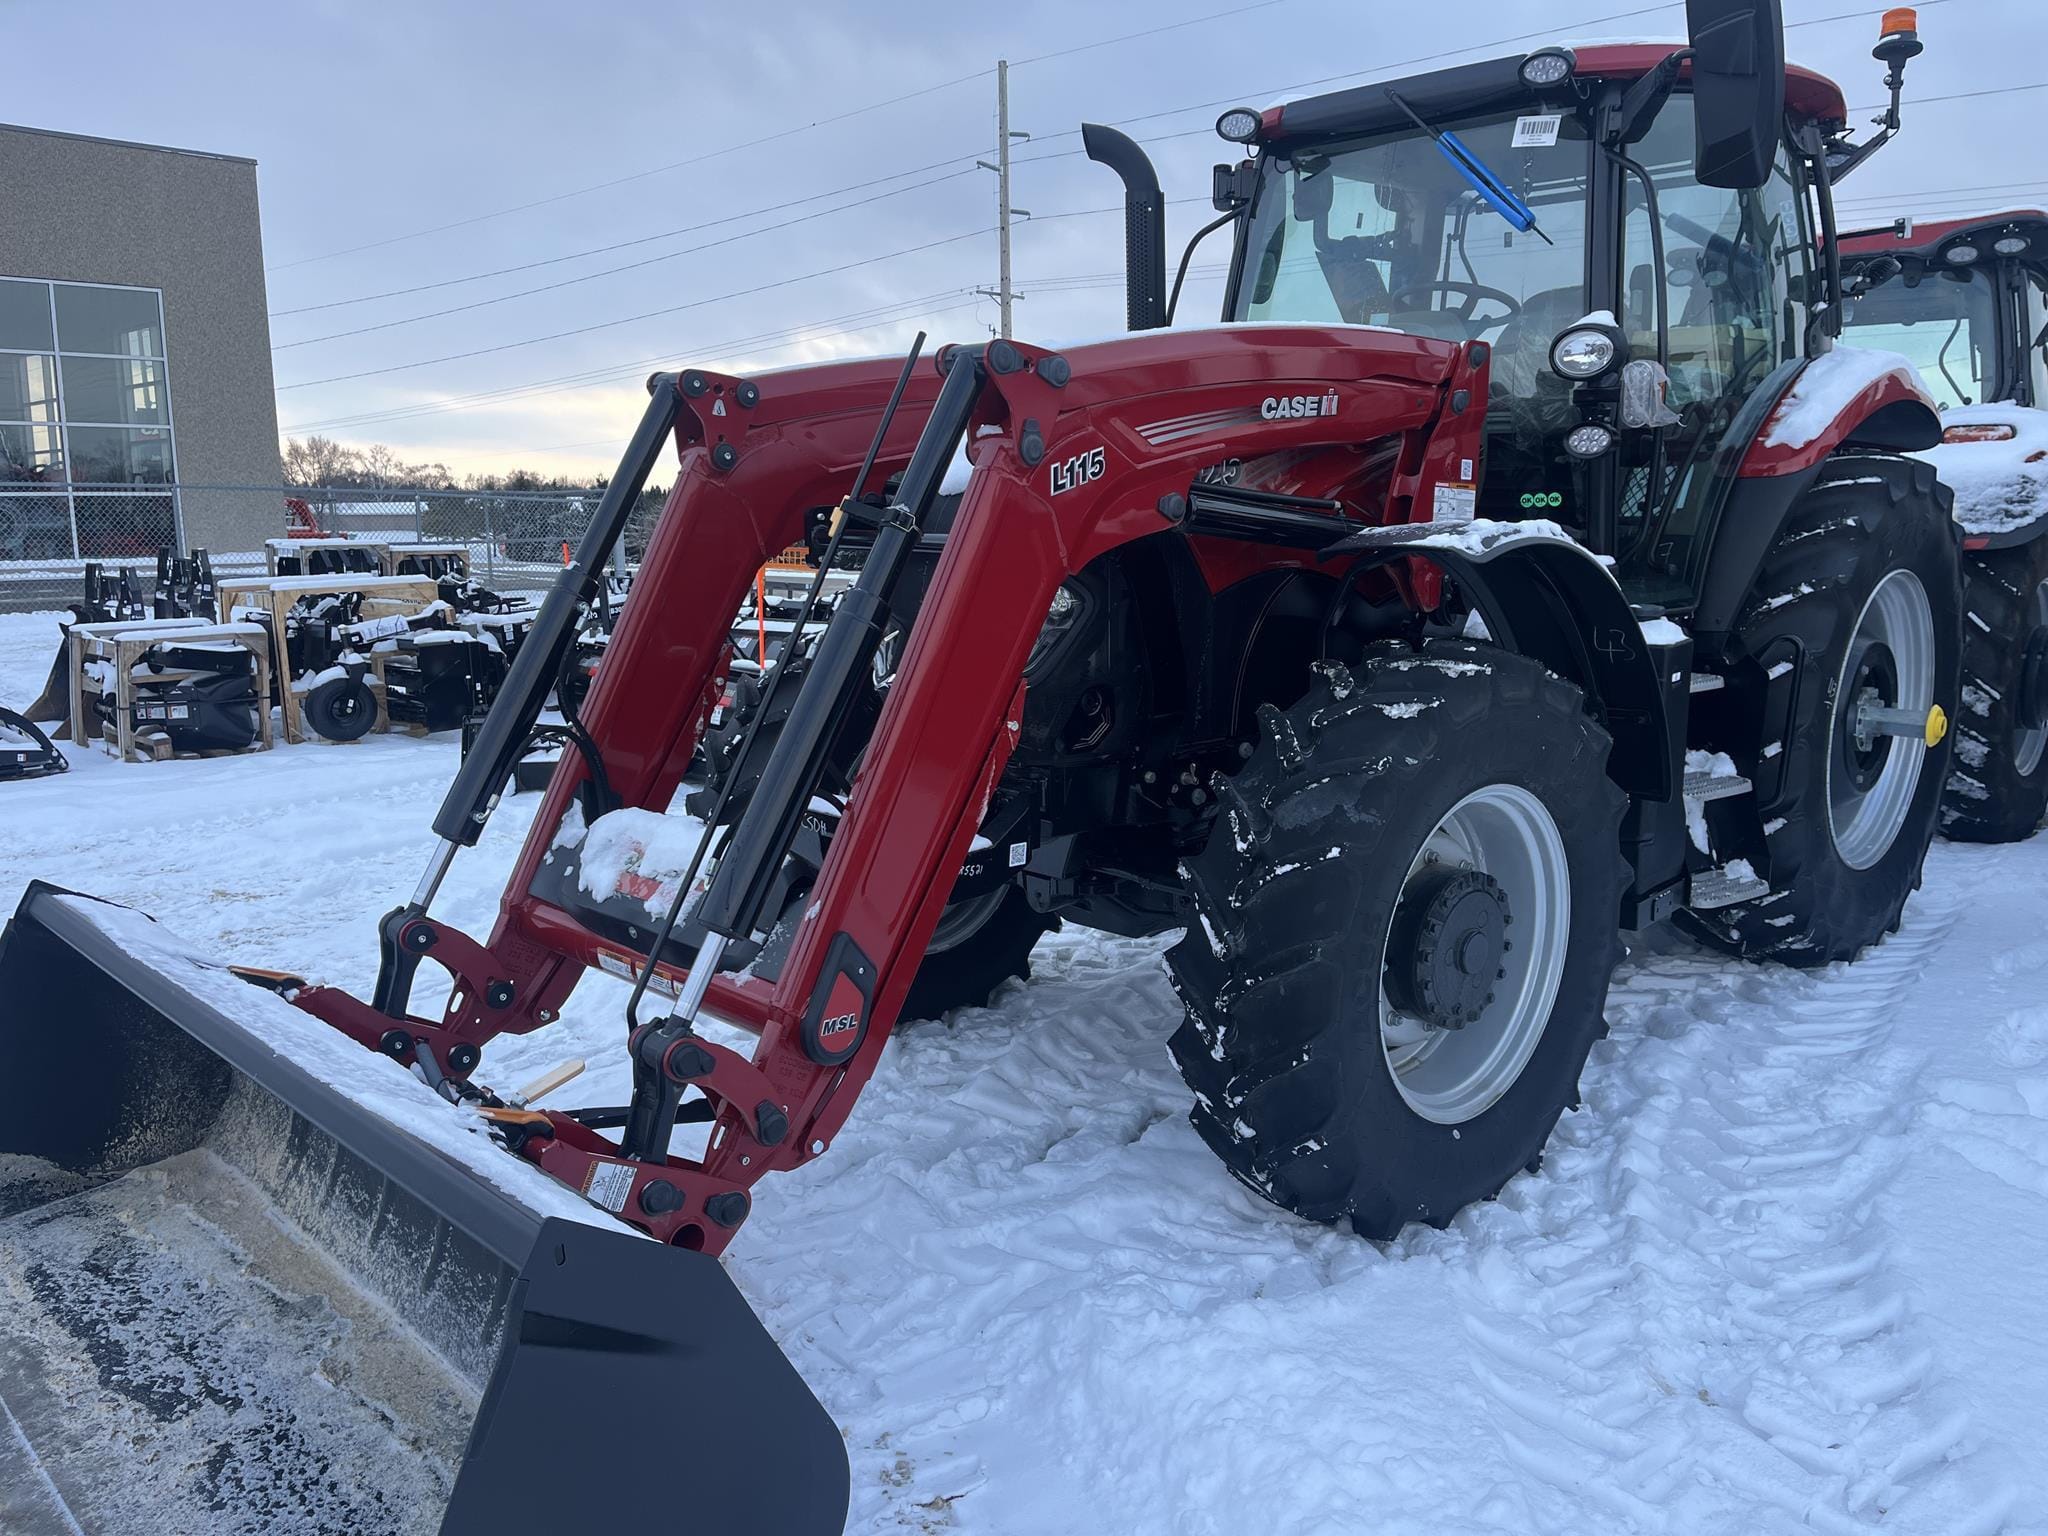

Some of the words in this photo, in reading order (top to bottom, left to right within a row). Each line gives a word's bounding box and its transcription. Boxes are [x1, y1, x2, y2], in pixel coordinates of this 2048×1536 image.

[1261, 396, 1320, 419] CASE
[1050, 445, 1106, 497] L115
[1593, 625, 1636, 664] 43
[821, 1013, 858, 1037] MSL
